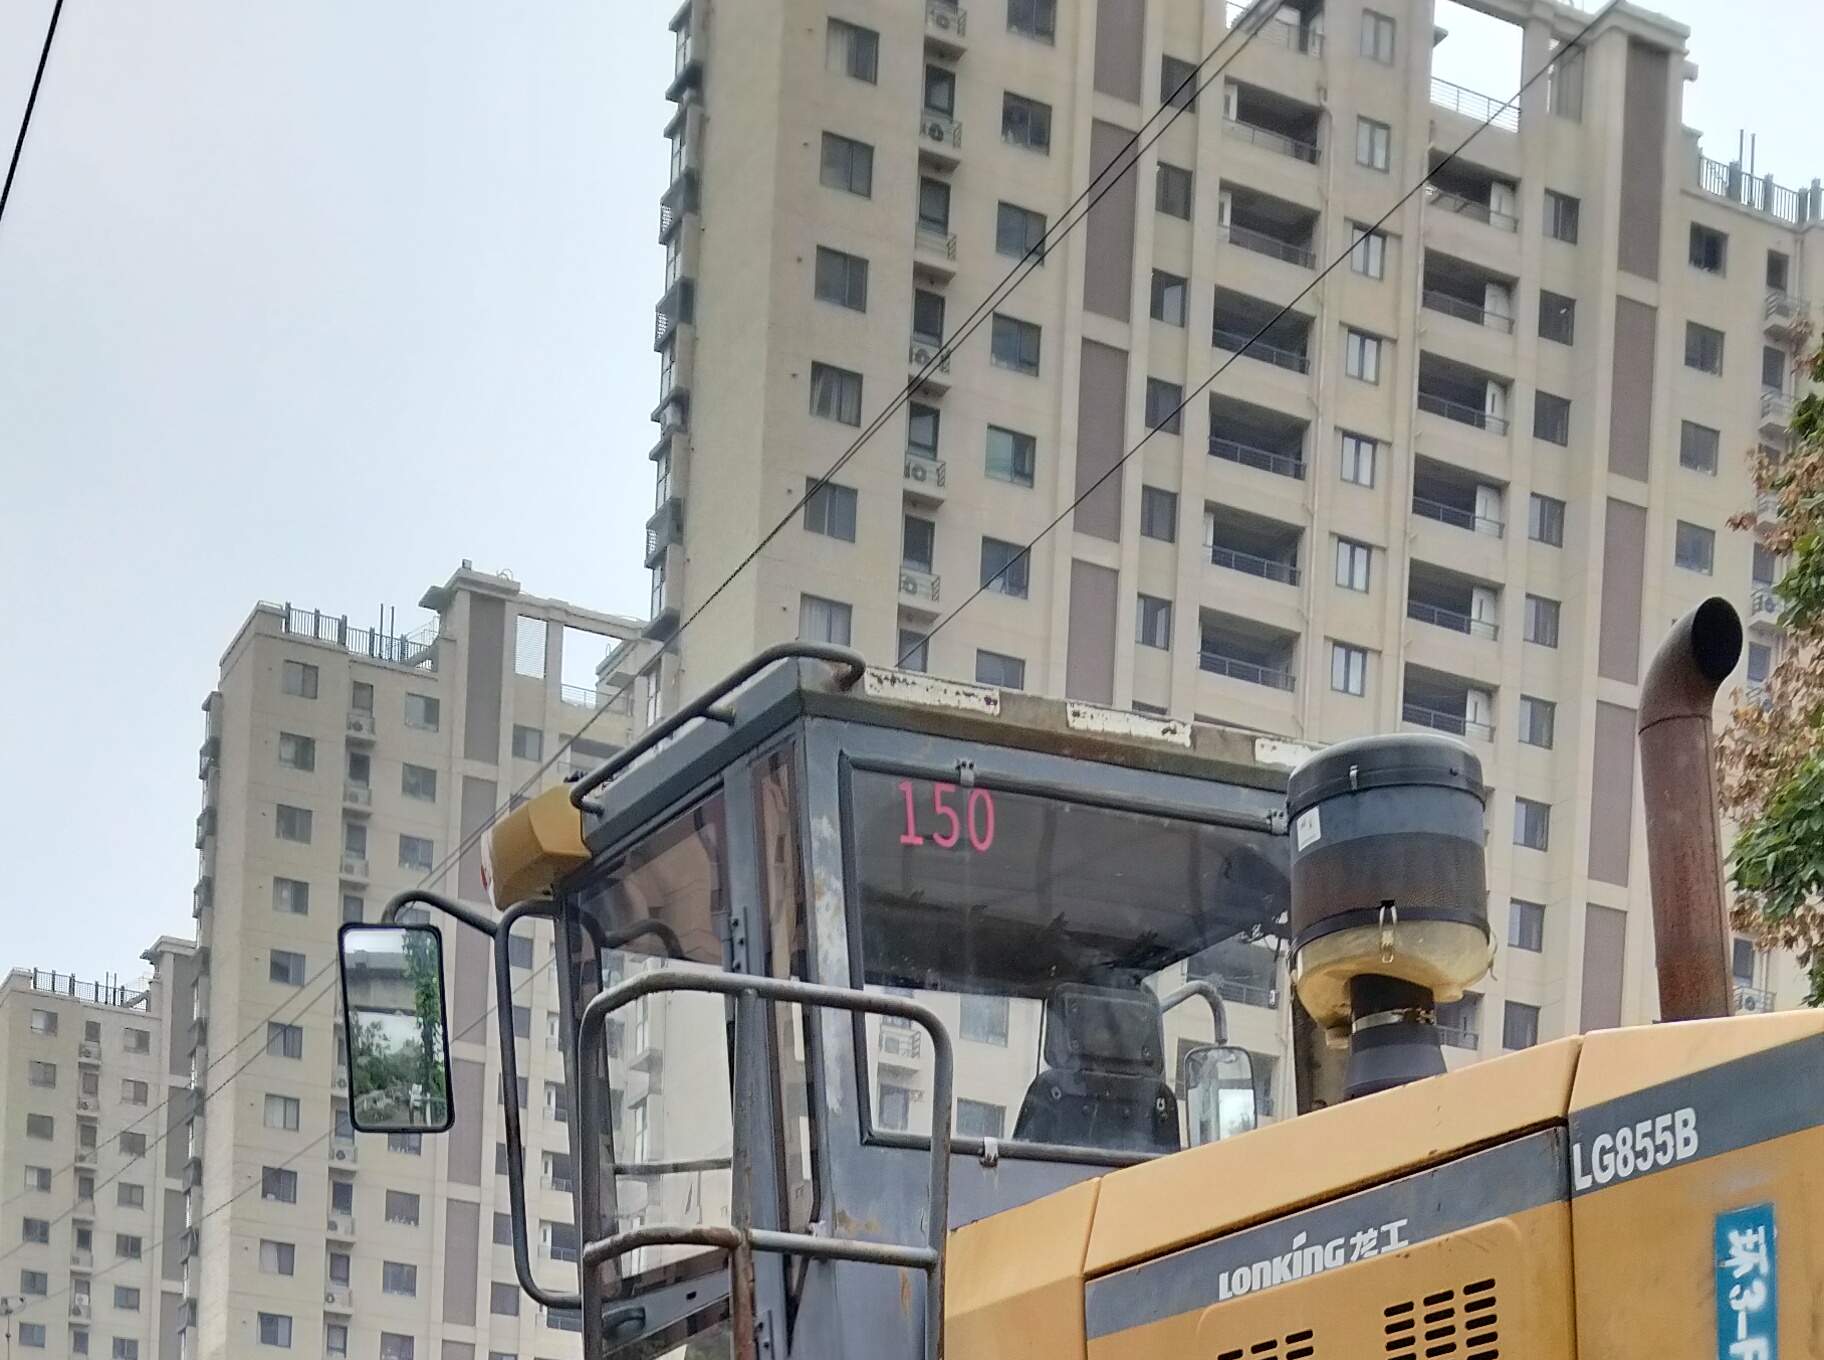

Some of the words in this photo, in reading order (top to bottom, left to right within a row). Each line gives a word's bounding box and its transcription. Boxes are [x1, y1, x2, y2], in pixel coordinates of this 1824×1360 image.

[898, 778, 995, 852] 150
[1572, 1107, 1699, 1191] LG855B
[1350, 1218, 1410, 1263] 龙工
